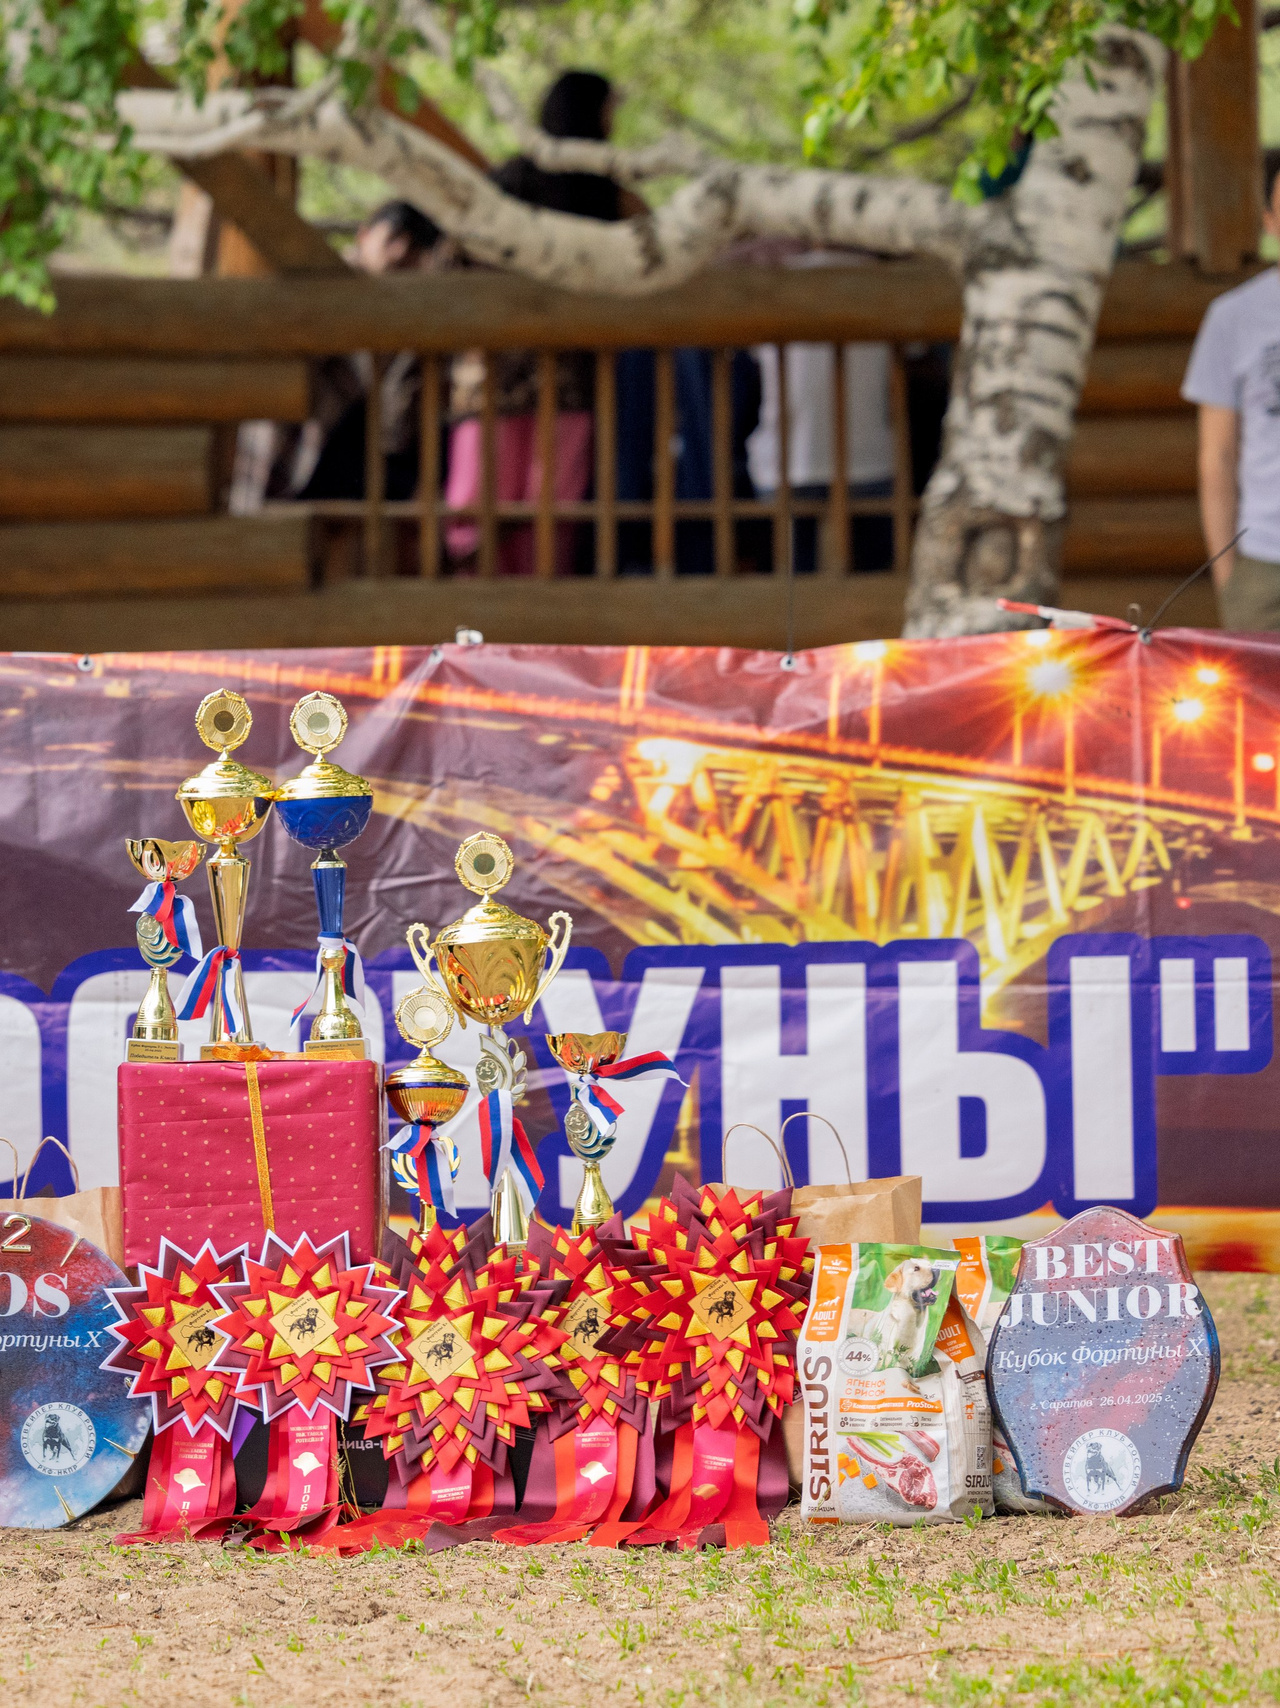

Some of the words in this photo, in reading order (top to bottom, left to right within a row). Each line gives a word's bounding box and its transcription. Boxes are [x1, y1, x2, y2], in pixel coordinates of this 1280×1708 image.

[1032, 1238, 1171, 1281] BEST
[812, 1311, 837, 1321] ADULT
[998, 1283, 1204, 1328] JUNIOR
[845, 1350, 872, 1362] 44%
[997, 1348, 1067, 1372] Кубок
[1071, 1343, 1182, 1367] Фортуны
[846, 1378, 887, 1388] ЯГНЕНОК
[1039, 1399, 1094, 1411] Саратов
[1100, 1393, 1163, 1407] 26.04.2025
[22, 1404, 53, 1455] РОТВЕЙЛЕР
[58, 1403, 84, 1417] КЛУБ
[84, 1418, 96, 1459] РОССИИ
[803, 1355, 833, 1502] SIRIUS
[1064, 1431, 1094, 1491] РОТВЕЙЛЕР
[1099, 1429, 1125, 1442] КЛУБ
[1127, 1443, 1141, 1487] РОССИИ
